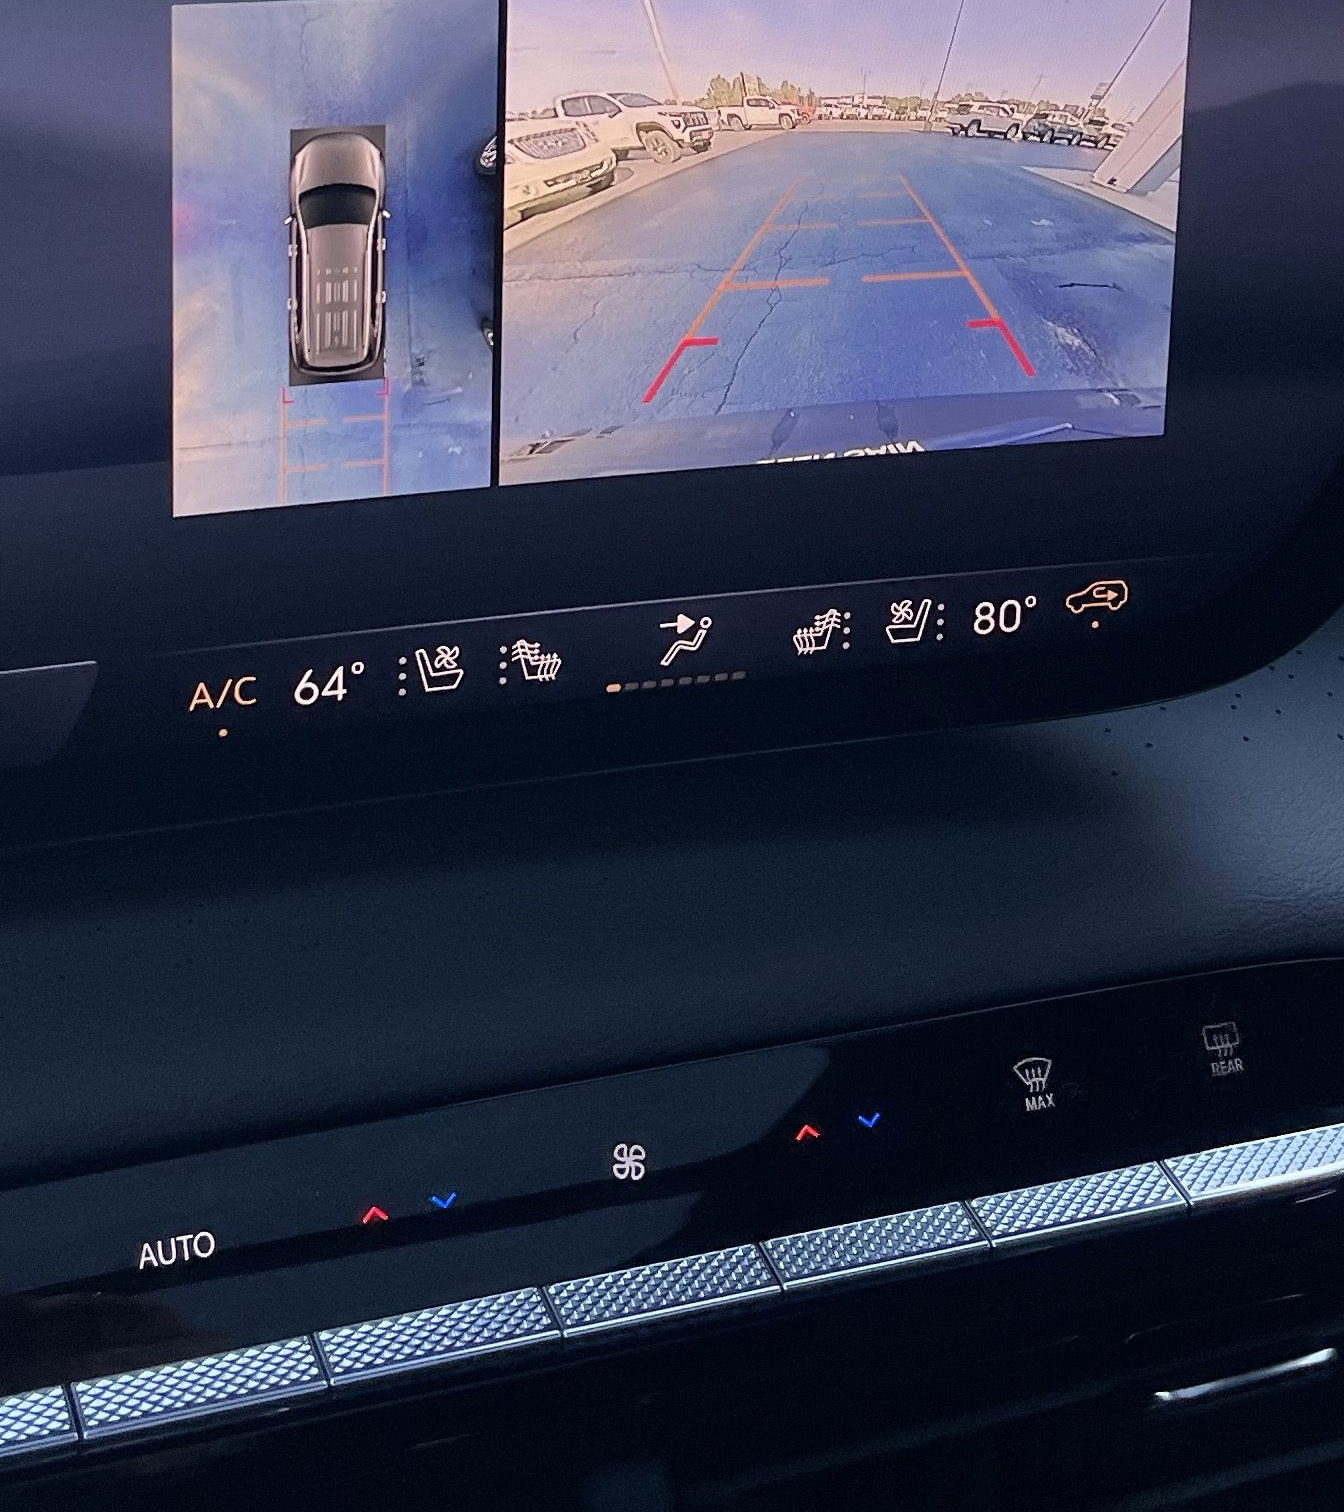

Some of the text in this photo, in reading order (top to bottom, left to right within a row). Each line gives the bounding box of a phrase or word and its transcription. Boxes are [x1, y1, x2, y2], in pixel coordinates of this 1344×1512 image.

[973, 595, 1037, 635] 80°
[188, 661, 365, 712] A/C 64°
[1210, 1058, 1244, 1076] REAR
[1025, 1092, 1056, 1112] MAX
[139, 1231, 216, 1270] AUTO
